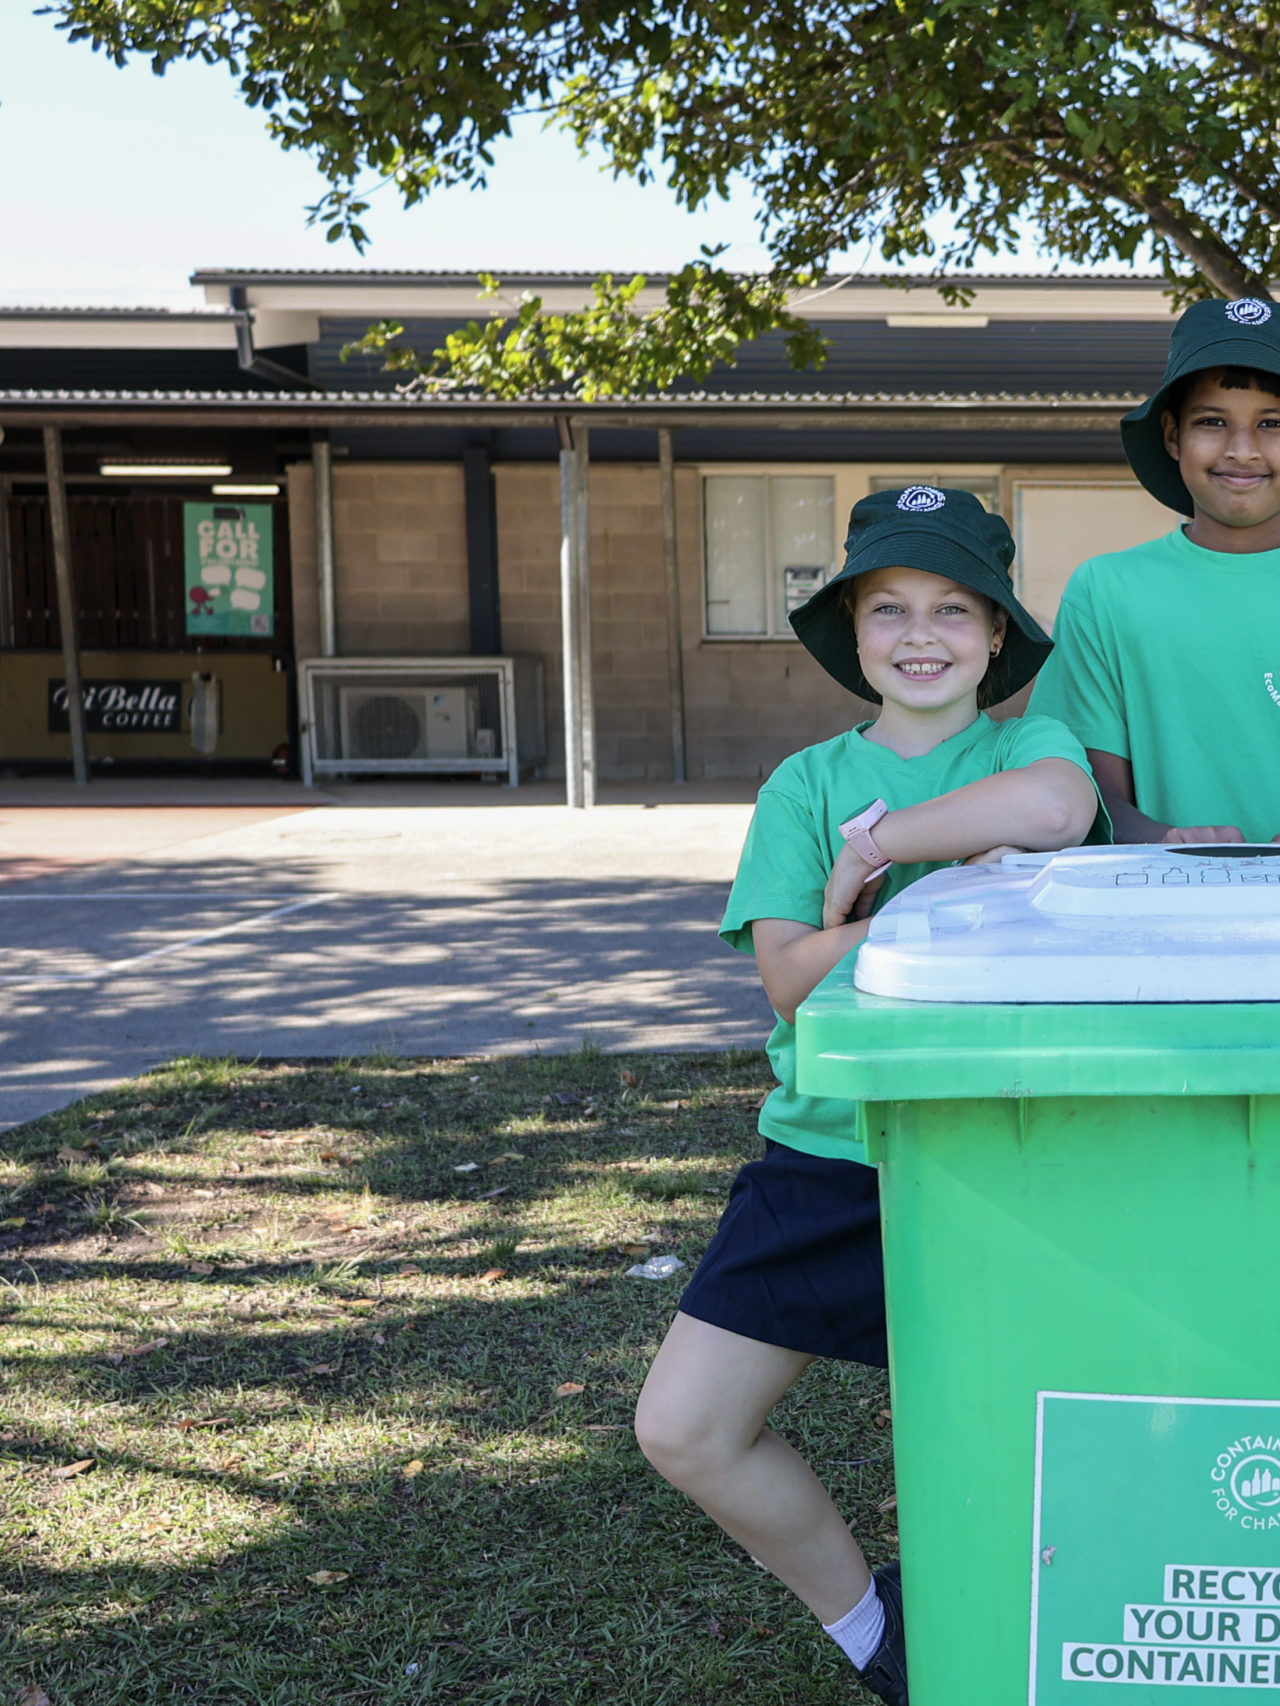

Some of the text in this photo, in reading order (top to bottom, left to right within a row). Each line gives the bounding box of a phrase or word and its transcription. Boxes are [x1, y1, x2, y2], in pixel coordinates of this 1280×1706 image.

[197, 520, 260, 539] CALL
[199, 538, 259, 560] FOR
[98, 685, 177, 711] Bella
[102, 711, 174, 727] COFFEE
[1212, 1487, 1239, 1521] FOR
[1130, 1609, 1240, 1642] YOUR
